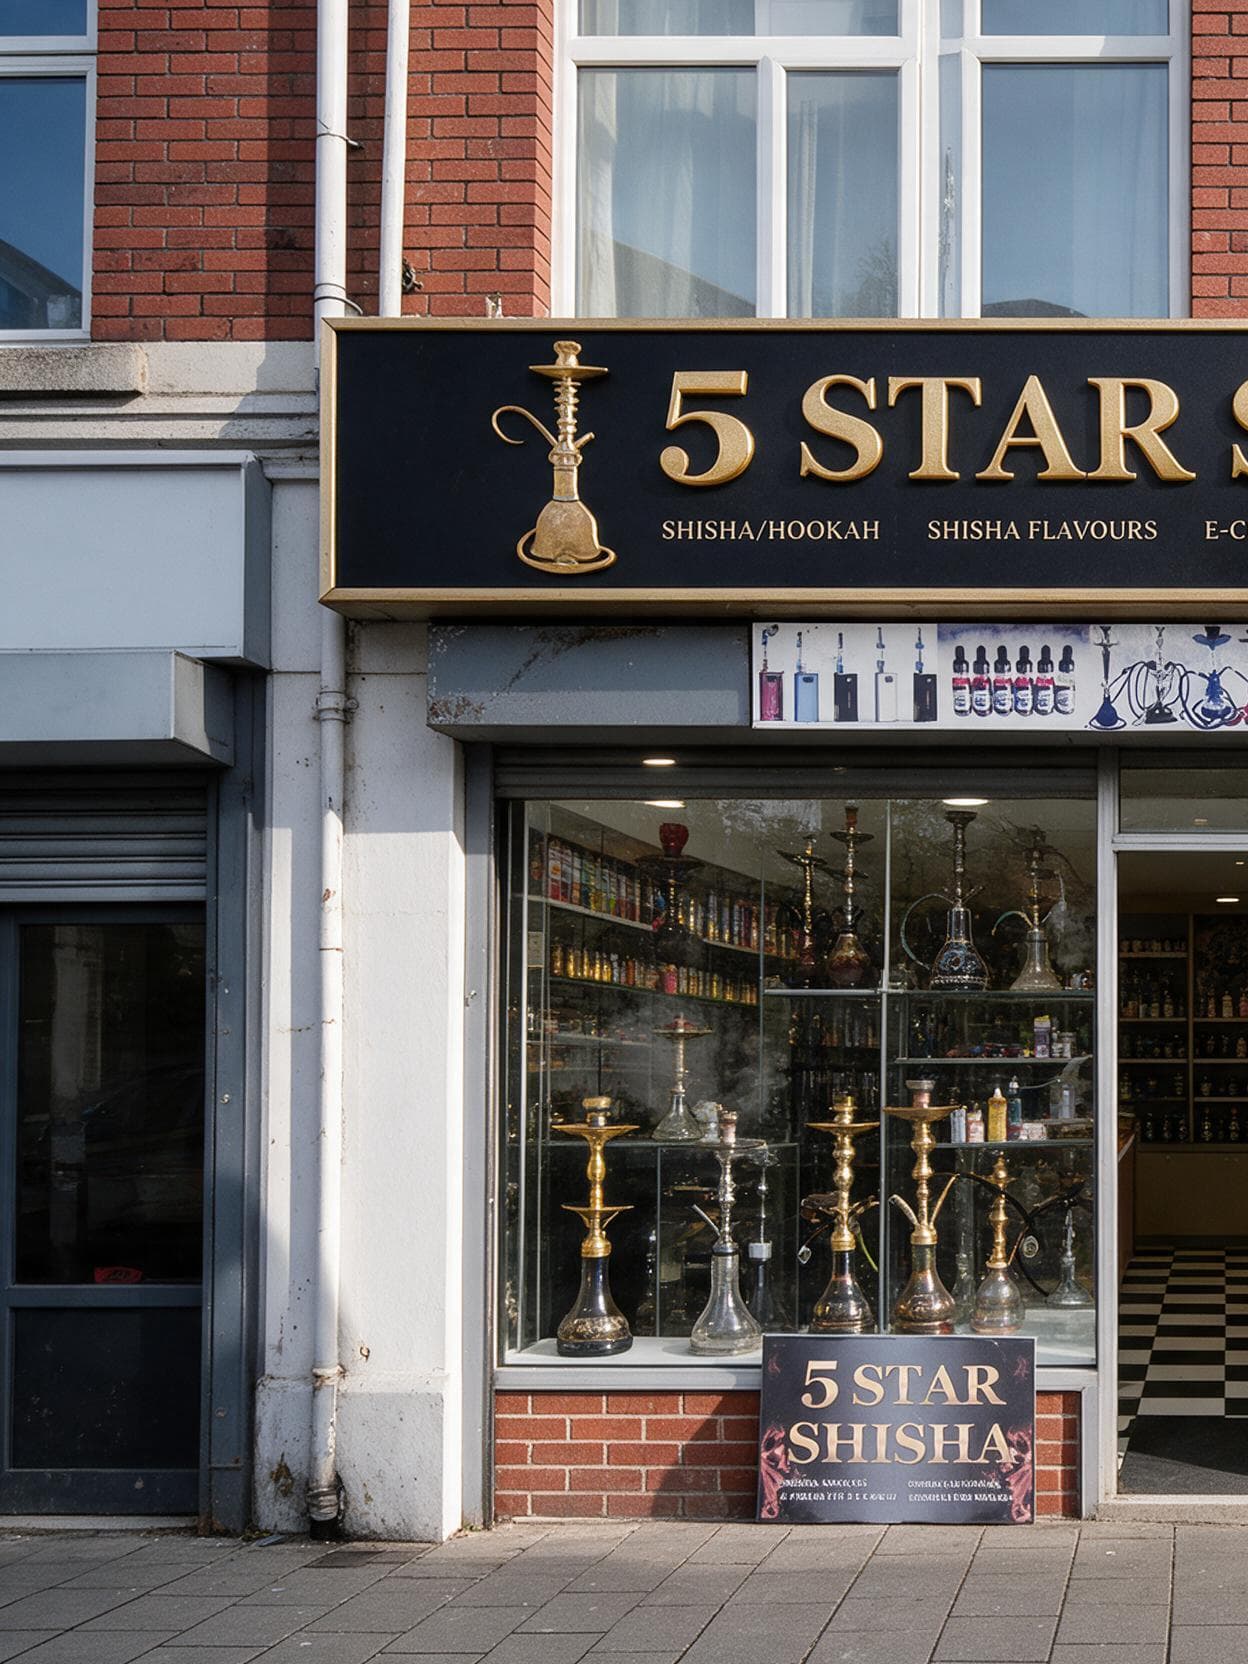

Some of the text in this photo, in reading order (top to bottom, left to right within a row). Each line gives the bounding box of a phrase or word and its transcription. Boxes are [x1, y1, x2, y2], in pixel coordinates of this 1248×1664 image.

[660, 370, 755, 486] 5
[800, 374, 1197, 481] STAR
[661, 519, 881, 541] SHISHA/HOOKAH
[927, 520, 1158, 541] SHISHA FLAVOURS
[801, 1360, 1008, 1409] 5 STAR
[787, 1421, 1018, 1465] SHISHA
